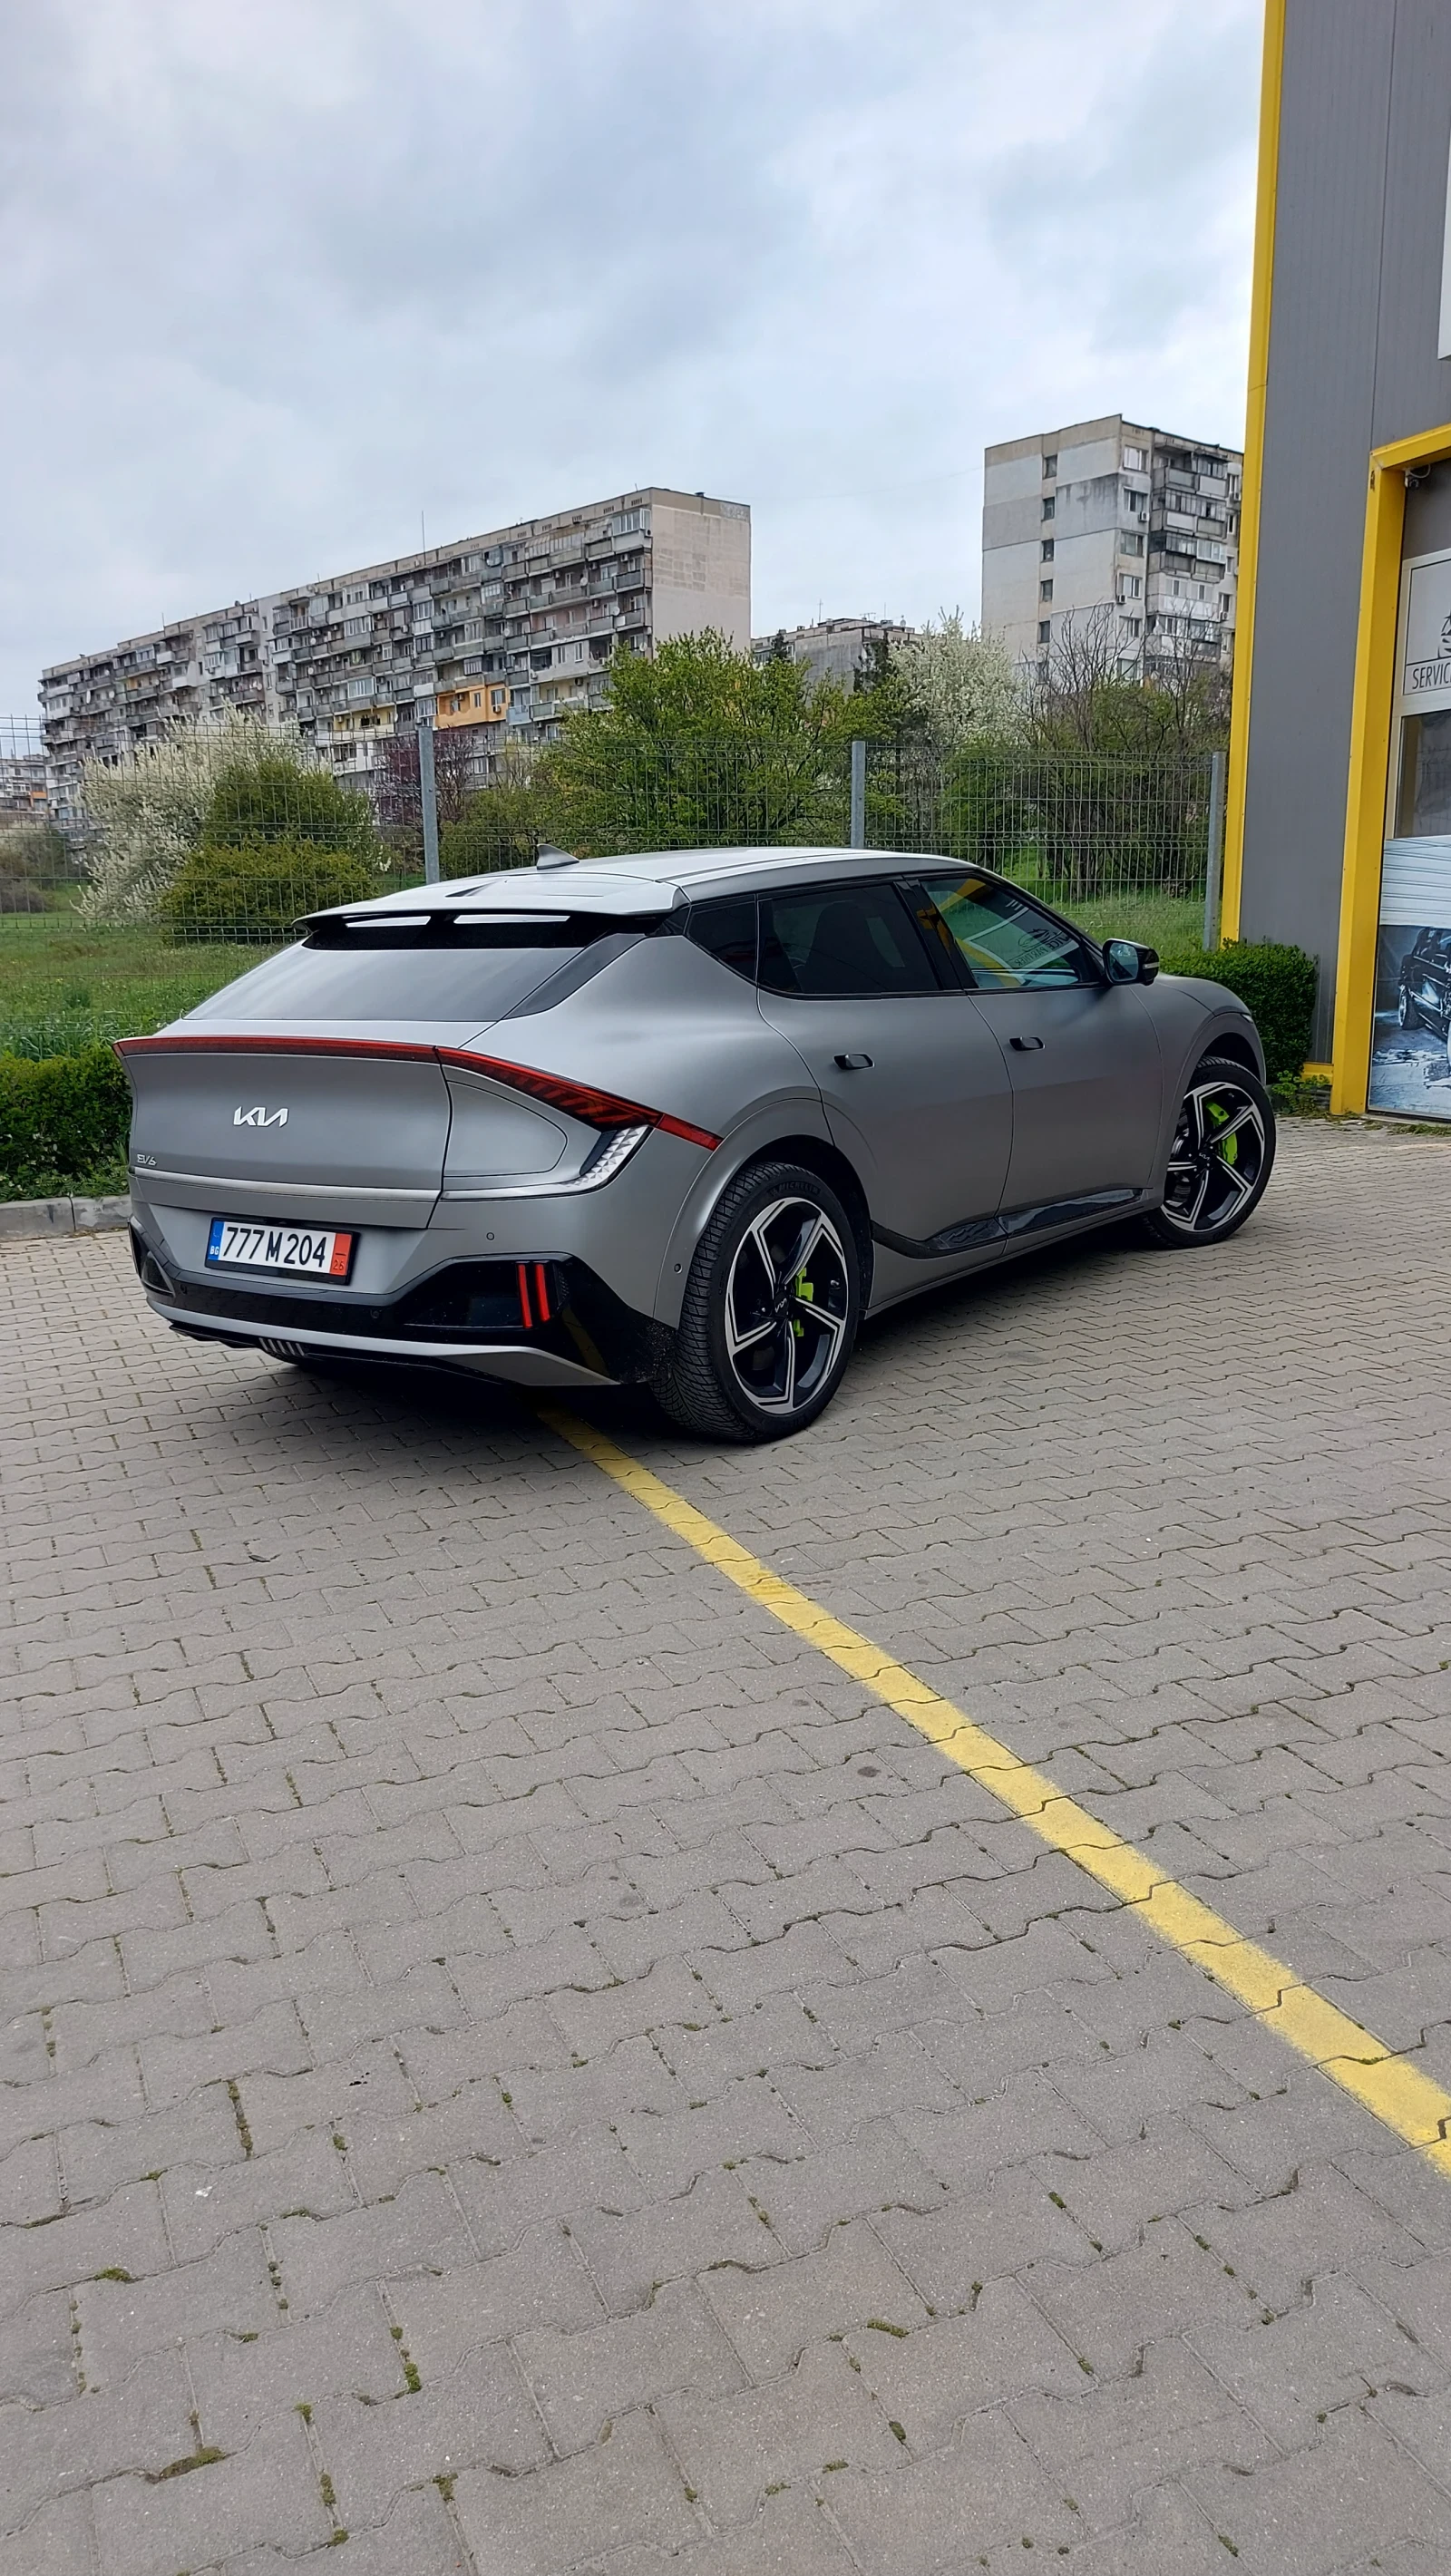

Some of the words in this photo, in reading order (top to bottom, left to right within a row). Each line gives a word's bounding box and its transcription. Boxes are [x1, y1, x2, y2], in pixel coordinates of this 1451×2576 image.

[1412, 662, 1451, 689] SERVIC
[233, 1106, 288, 1127] KIA
[209, 1245, 220, 1256] BG
[333, 1259, 345, 1271] 26
